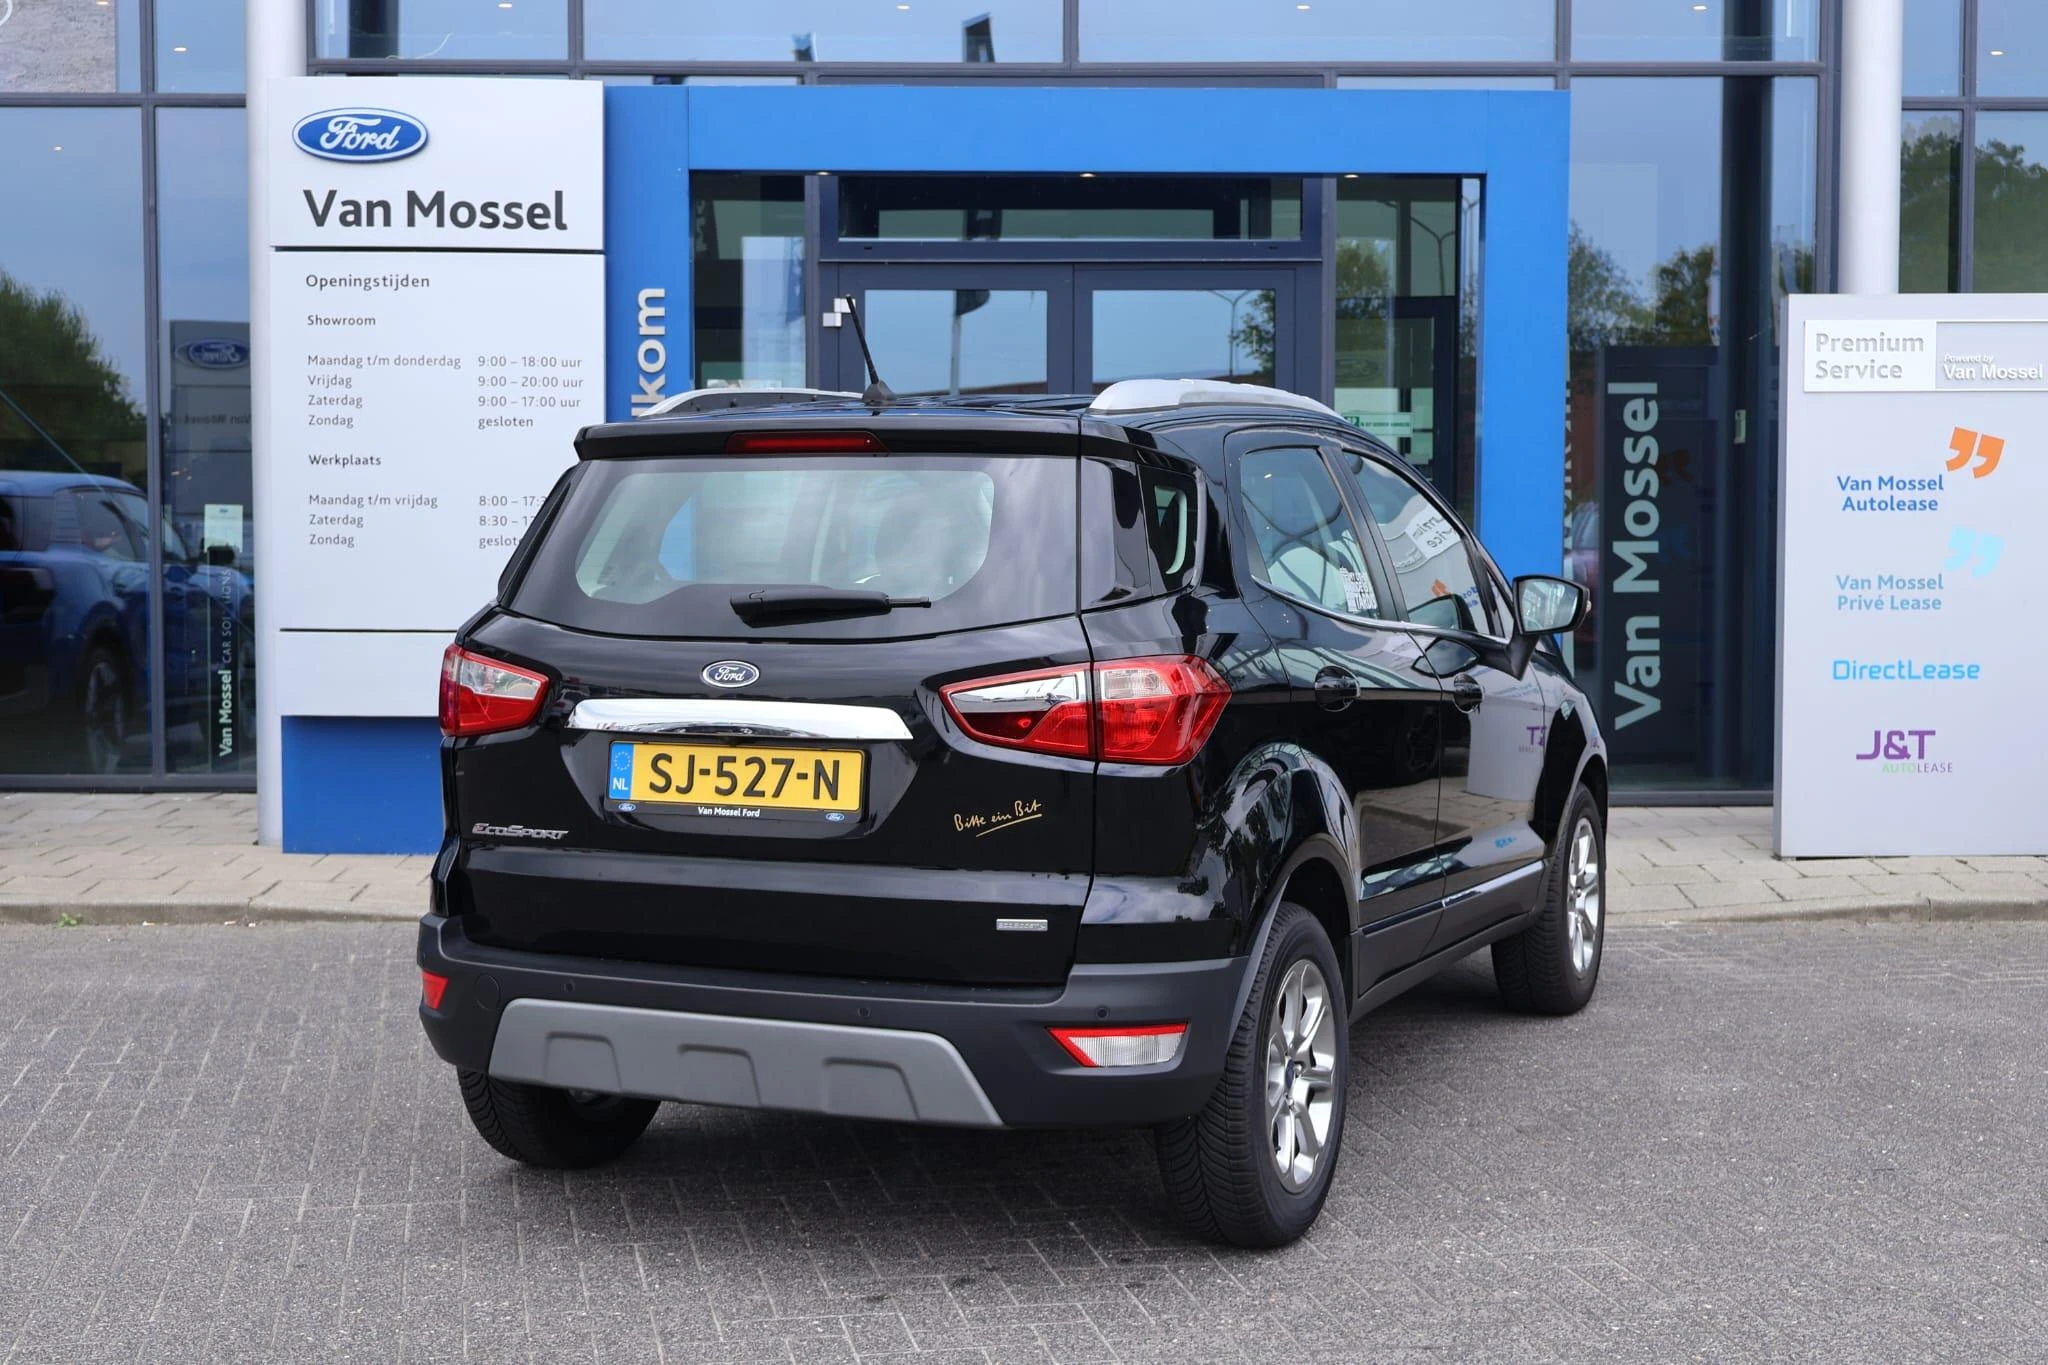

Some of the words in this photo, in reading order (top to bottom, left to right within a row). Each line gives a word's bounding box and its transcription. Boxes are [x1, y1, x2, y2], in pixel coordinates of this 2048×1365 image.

[303, 189, 392, 228] Van
[406, 190, 568, 231] Mossel
[306, 274, 430, 291] Openingstijden
[307, 314, 376, 326] Showroom
[1815, 332, 1925, 353] Premium
[308, 354, 363, 369] Maandag
[366, 354, 390, 367] t/m
[394, 354, 462, 370] donderdag
[478, 356, 507, 368] 9:00
[522, 356, 557, 368] 18:00
[561, 359, 582, 368] uur
[1984, 353, 1994, 364] by
[1815, 359, 1903, 379] Service
[1943, 363, 1976, 380] Van
[1982, 363, 2043, 380] Mossel
[308, 374, 353, 389] Vrijdag
[478, 376, 507, 388] 9:00
[521, 376, 559, 388] 20:00
[562, 379, 584, 388] uur
[308, 394, 363, 409] Zaterdag
[478, 396, 507, 408] 9:00
[522, 396, 557, 408] 17:00
[560, 399, 582, 408] uur
[308, 414, 354, 430] Zondag
[478, 415, 534, 431] gesloten
[308, 454, 382, 468] Werkplaats
[1607, 382, 1660, 593] Mossel
[1837, 475, 1872, 491] Van
[1878, 474, 1944, 491] Mossel
[309, 494, 365, 509] Maandag
[368, 494, 391, 506] t/m
[395, 494, 438, 509] vrijdag
[479, 495, 508, 507] 8:00
[1842, 495, 1939, 512] Autolease
[309, 514, 364, 529] Zaterdag
[479, 515, 508, 527] 8:30
[309, 533, 355, 549] Zondag
[479, 535, 520, 549] geslot
[1836, 574, 1872, 590] Van
[1878, 573, 1944, 590] Mossel
[1837, 594, 1885, 611] Privé
[1890, 595, 1942, 611] Lease
[222, 641, 232, 664] CAR
[1614, 615, 1661, 731] Van
[1832, 659, 1981, 681] DirectLease
[217, 669, 232, 723] Mossel
[219, 724, 232, 758] Van
[1855, 730, 1937, 760] J&T
[648, 752, 840, 801] SJ-527-N
[1882, 762, 1953, 774] AUTOLEASE
[613, 778, 629, 791] NL
[698, 806, 713, 816] Van
[713, 807, 741, 817] Mossel
[742, 808, 761, 818] Ford
[954, 813, 986, 832] Bitte
[991, 811, 1012, 823] ein
[1014, 800, 1042, 817] Bit
